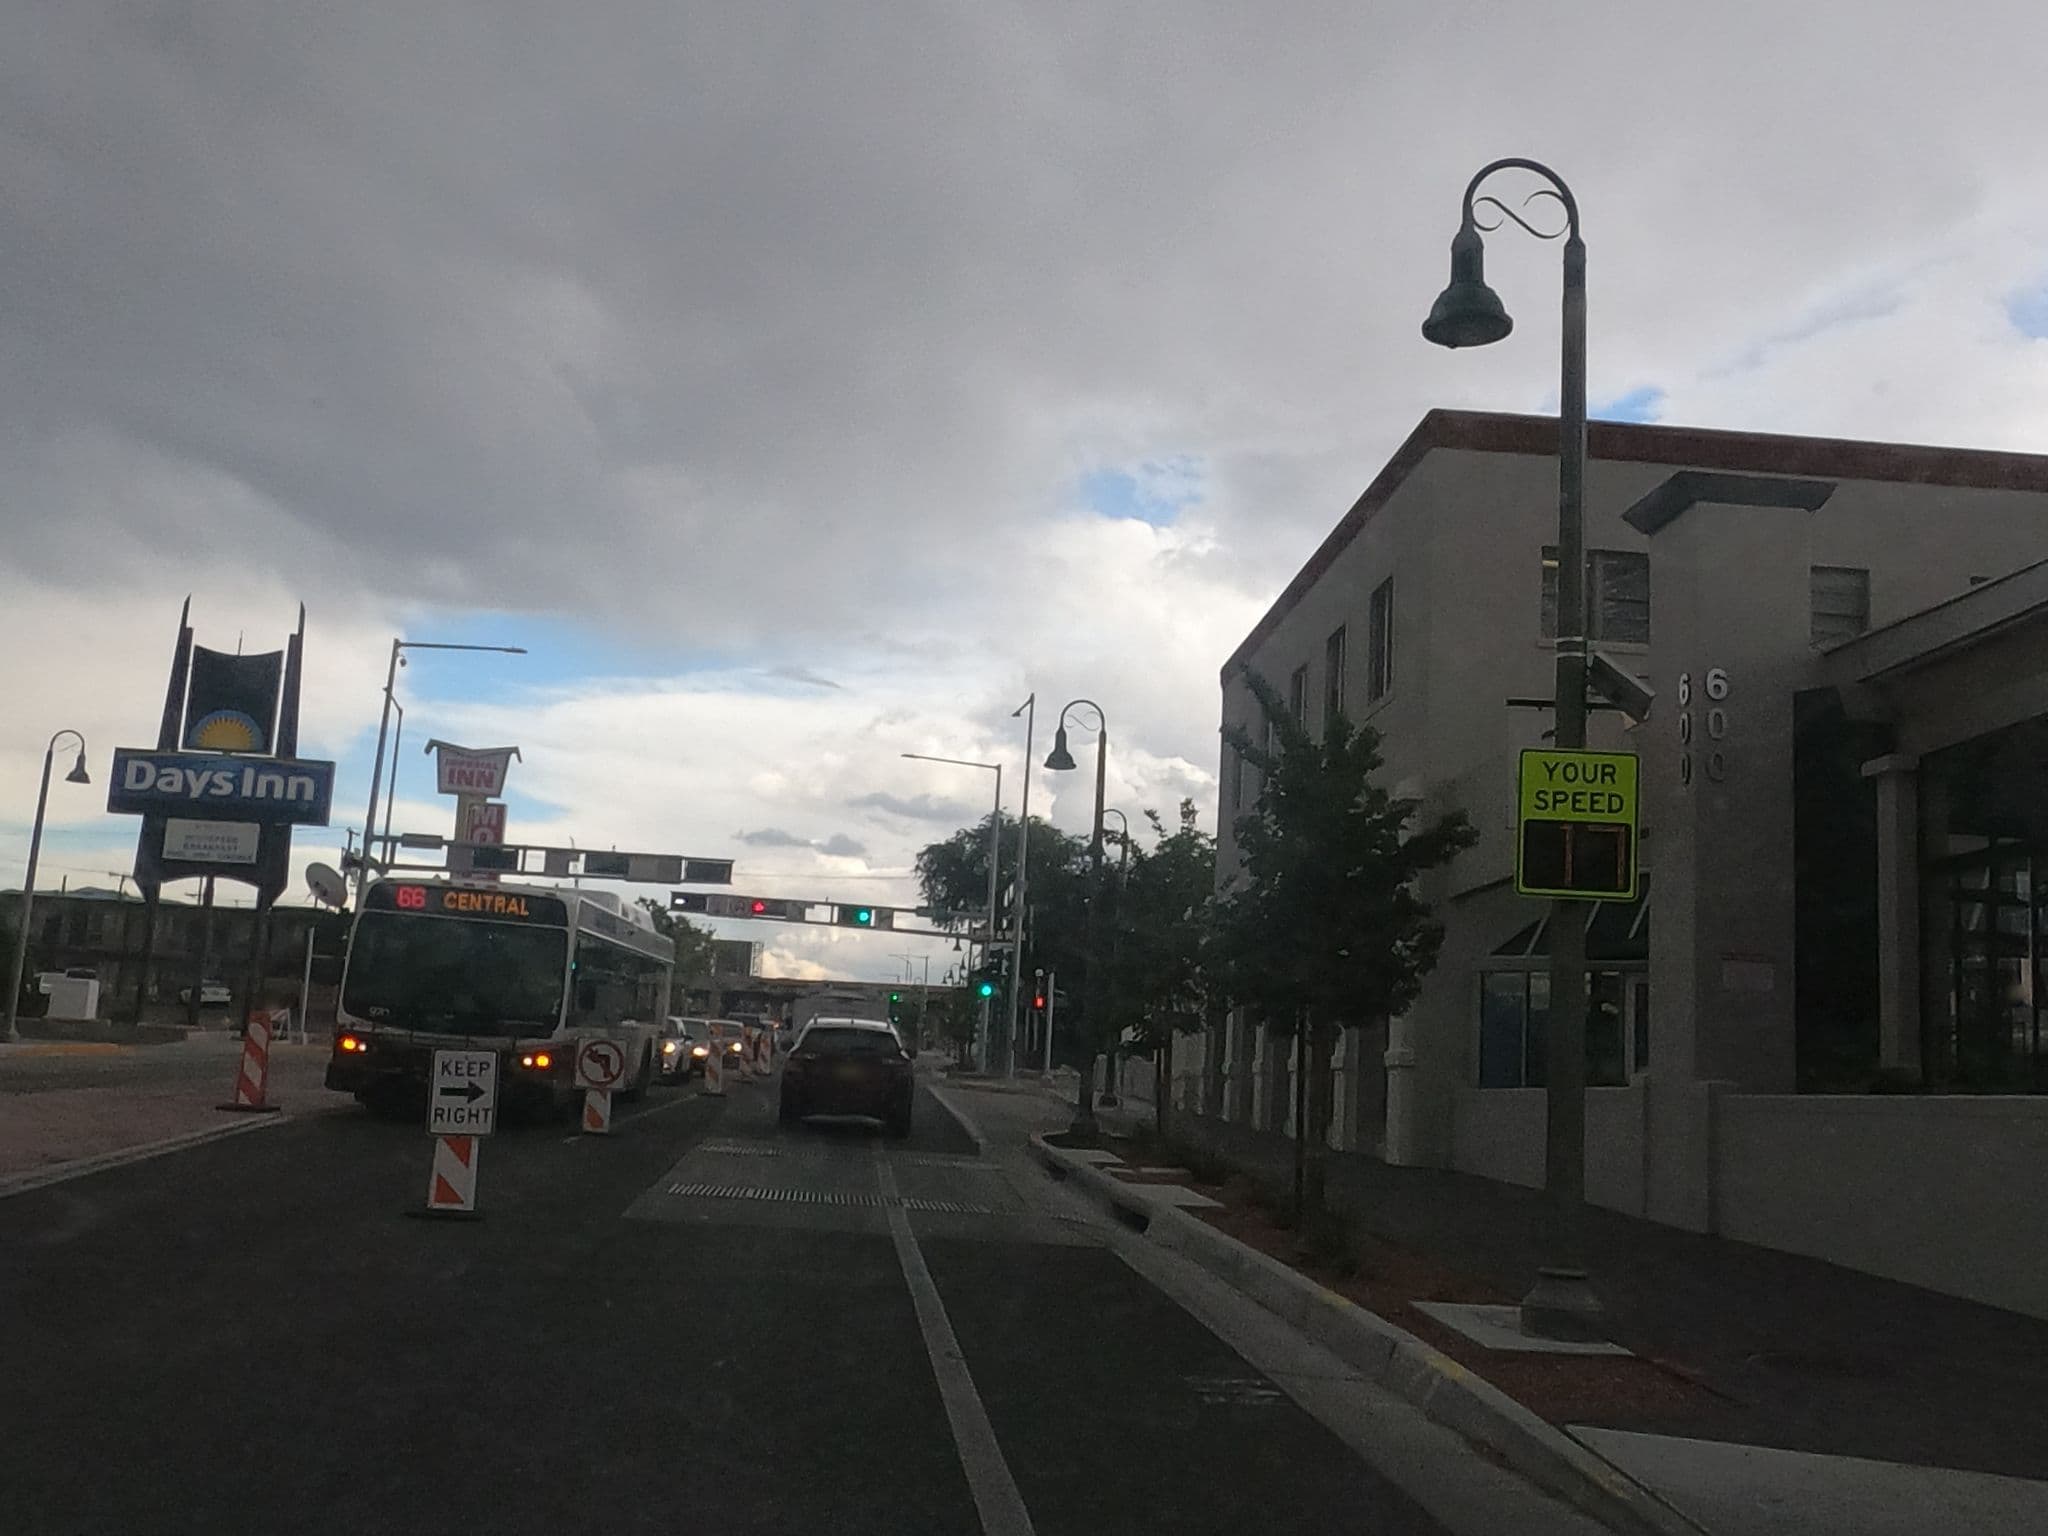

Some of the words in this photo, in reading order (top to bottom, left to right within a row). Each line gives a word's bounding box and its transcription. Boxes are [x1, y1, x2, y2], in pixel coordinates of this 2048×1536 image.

[123, 760, 235, 799] Days
[241, 767, 315, 800] Inn
[448, 769, 494, 789] INN
[1543, 760, 1616, 784] YOUR
[1534, 790, 1624, 814] SPEED
[396, 886, 426, 908] 66
[444, 890, 529, 916] CENTRAL
[441, 1060, 490, 1077] KEEP
[433, 1107, 491, 1125] RIGHT
